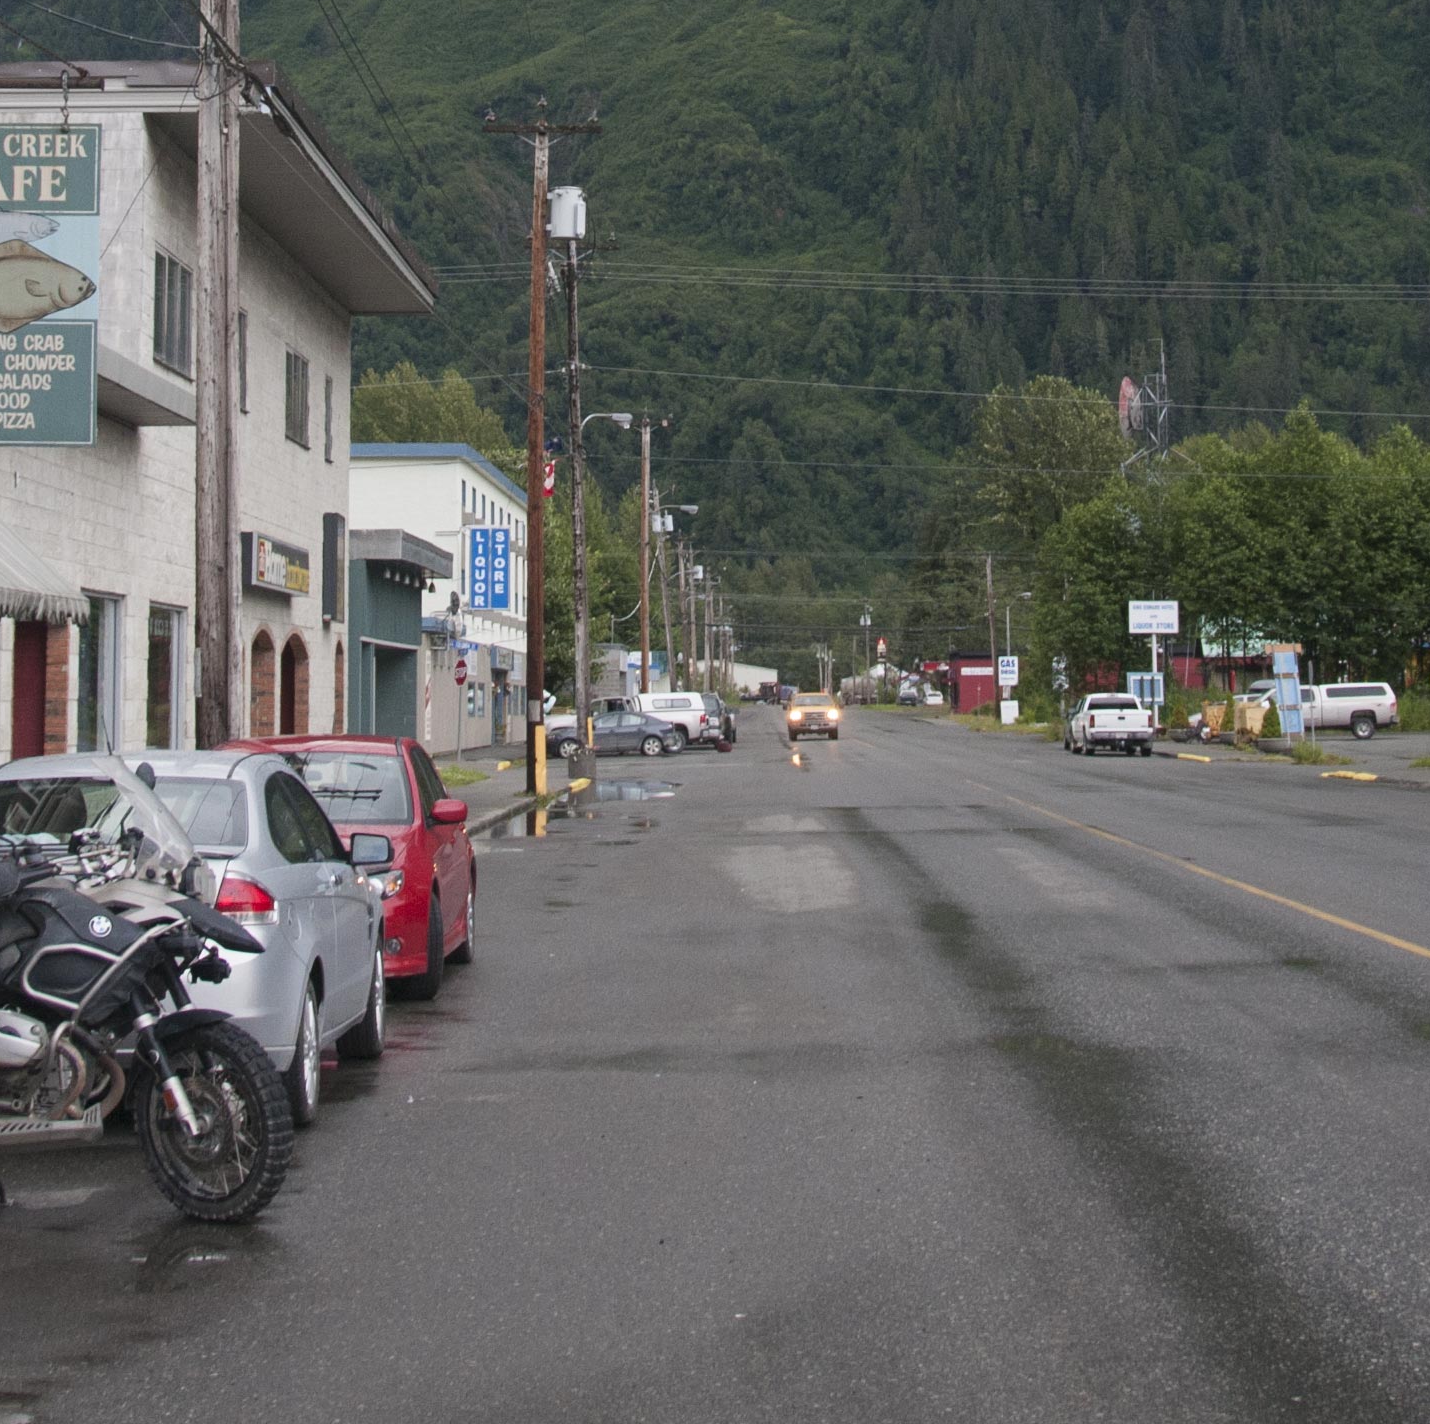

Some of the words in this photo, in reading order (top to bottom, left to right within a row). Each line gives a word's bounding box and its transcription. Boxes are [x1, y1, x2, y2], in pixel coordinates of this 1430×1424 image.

[3, 134, 88, 158] CREEK
[24, 334, 64, 352] CRAB
[4, 354, 76, 371] CHOWDER
[474, 531, 486, 607] LIQUOR
[494, 531, 506, 594] STORE
[1000, 659, 1015, 667] GAS
